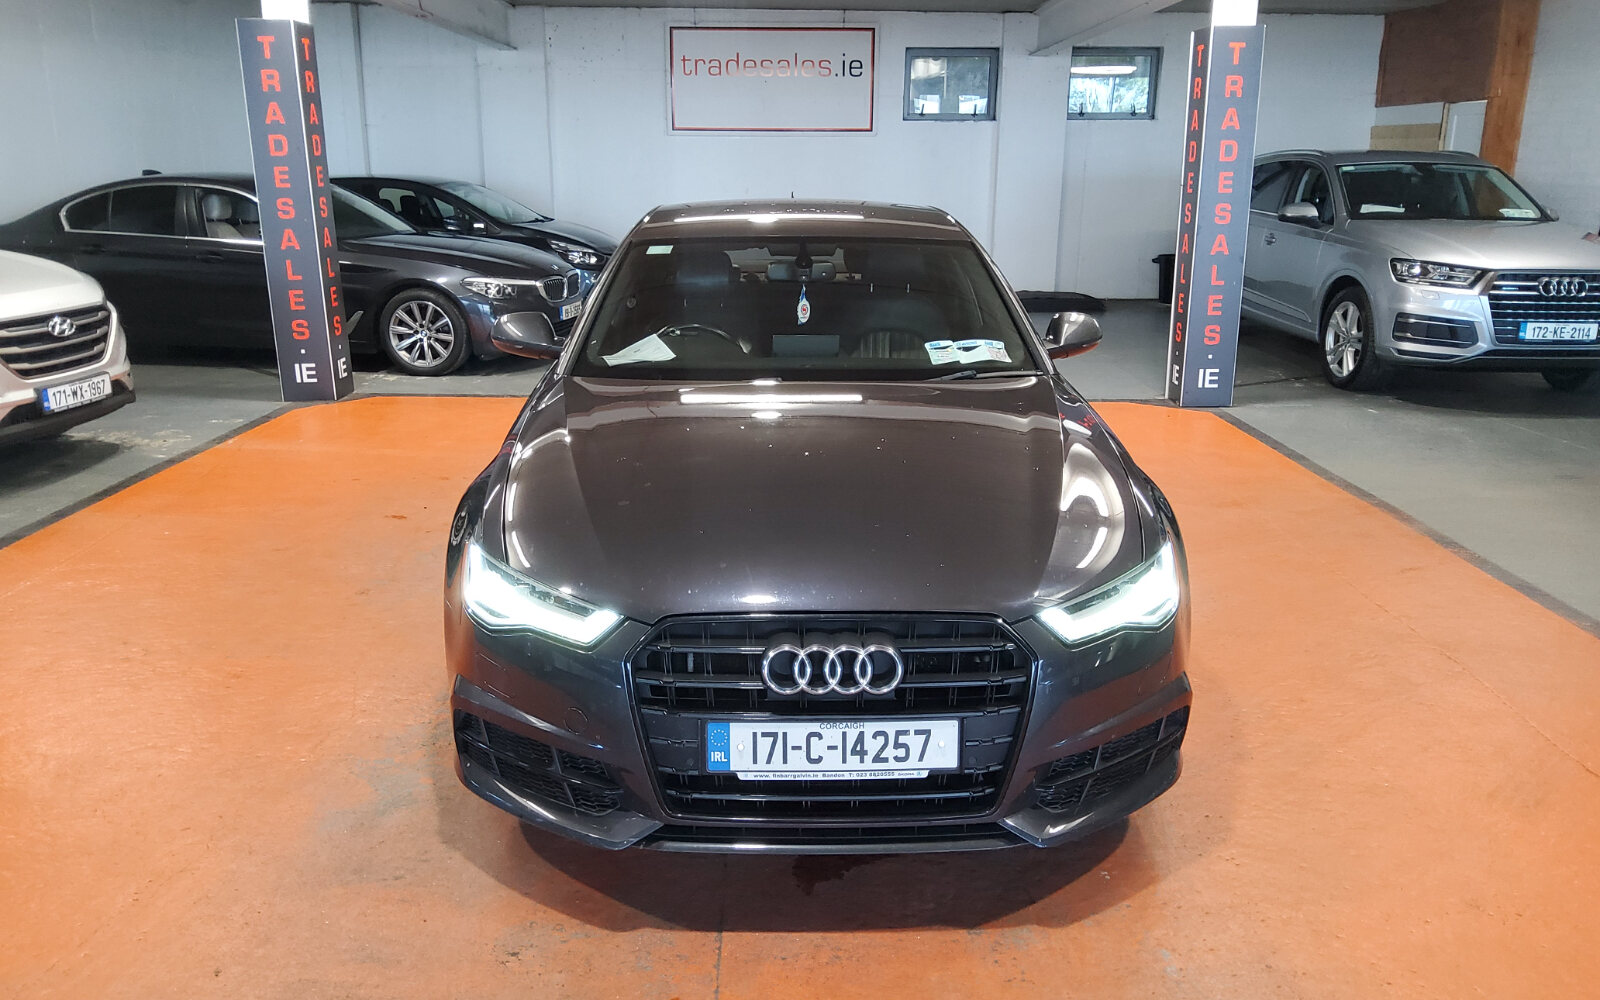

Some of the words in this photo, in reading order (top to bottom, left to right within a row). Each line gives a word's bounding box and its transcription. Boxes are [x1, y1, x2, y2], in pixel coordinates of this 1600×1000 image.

[681, 52, 864, 78] tradesales.ie
[1532, 326, 1591, 340] 172-KE-2114
[52, 379, 106, 407] 171-WX-1967
[819, 722, 865, 730] CORCAIGH
[711, 751, 728, 762] IRL
[752, 729, 932, 765] 171-C-14257
